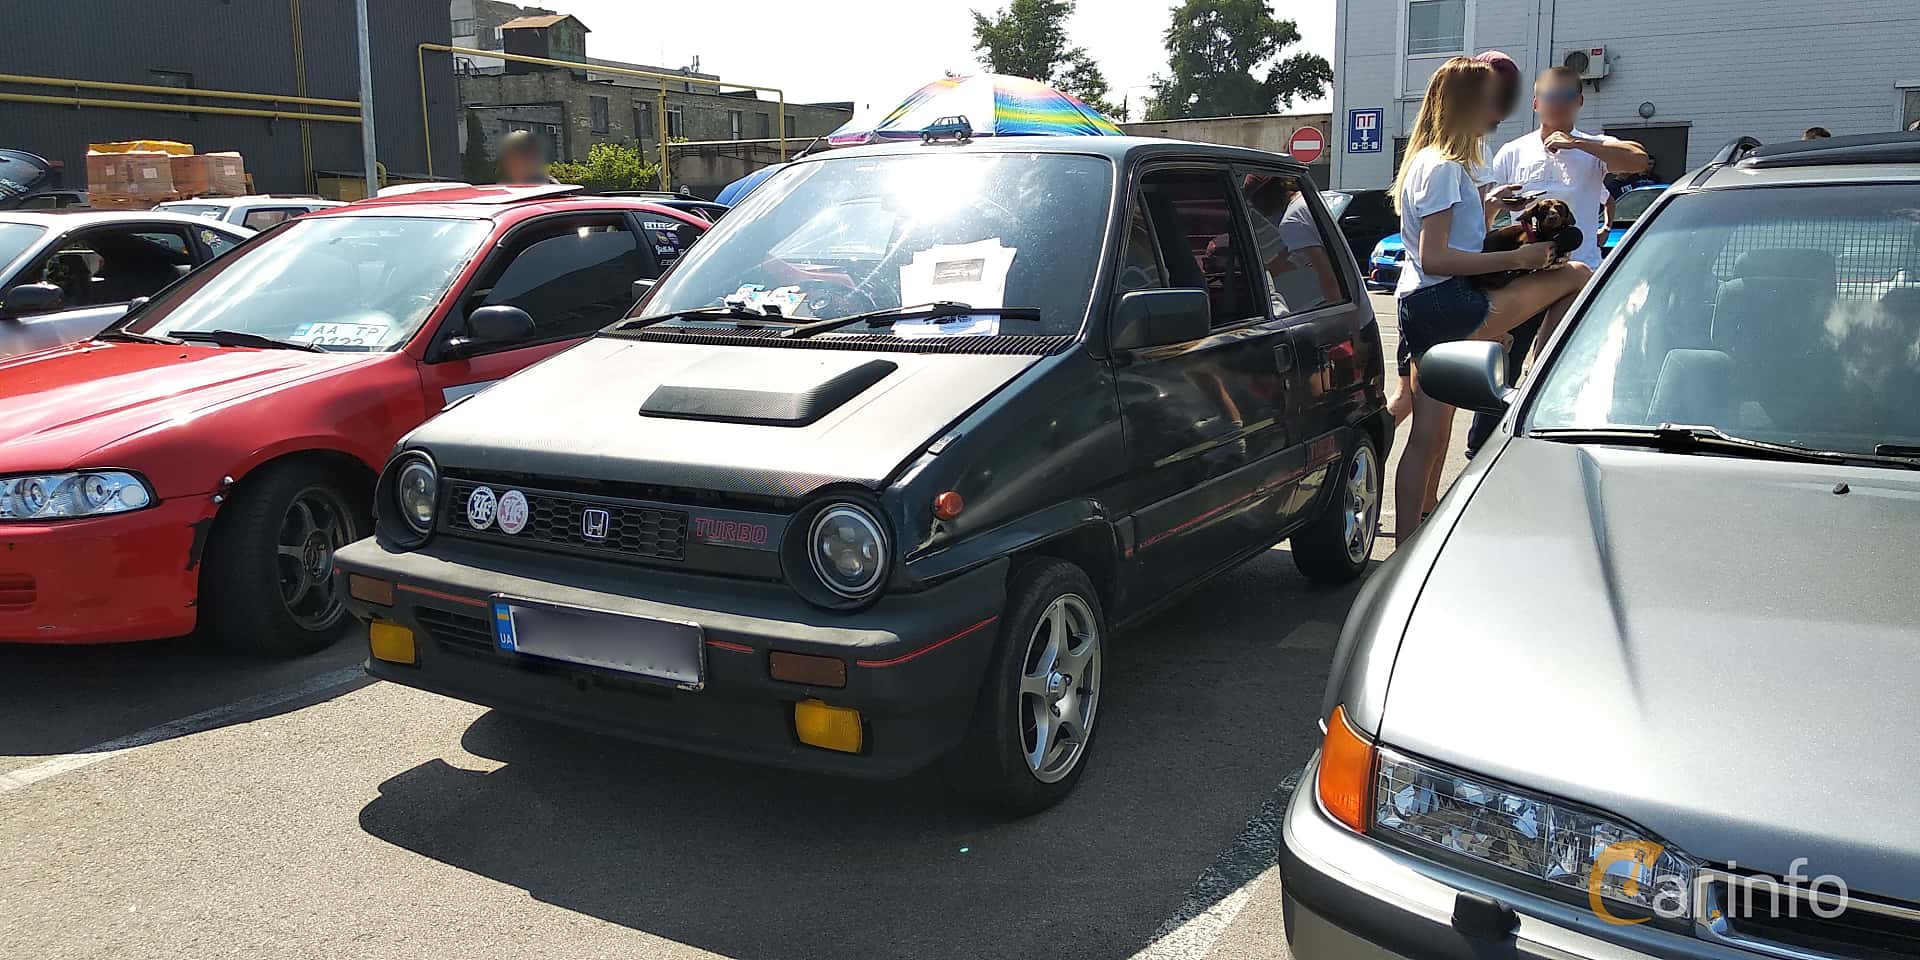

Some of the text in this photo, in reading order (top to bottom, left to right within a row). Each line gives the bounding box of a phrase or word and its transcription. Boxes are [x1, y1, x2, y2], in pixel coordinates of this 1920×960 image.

[313, 325, 338, 335] AA
[356, 326, 380, 336] TP
[695, 517, 769, 545] TURBO
[500, 632, 513, 645] UA
